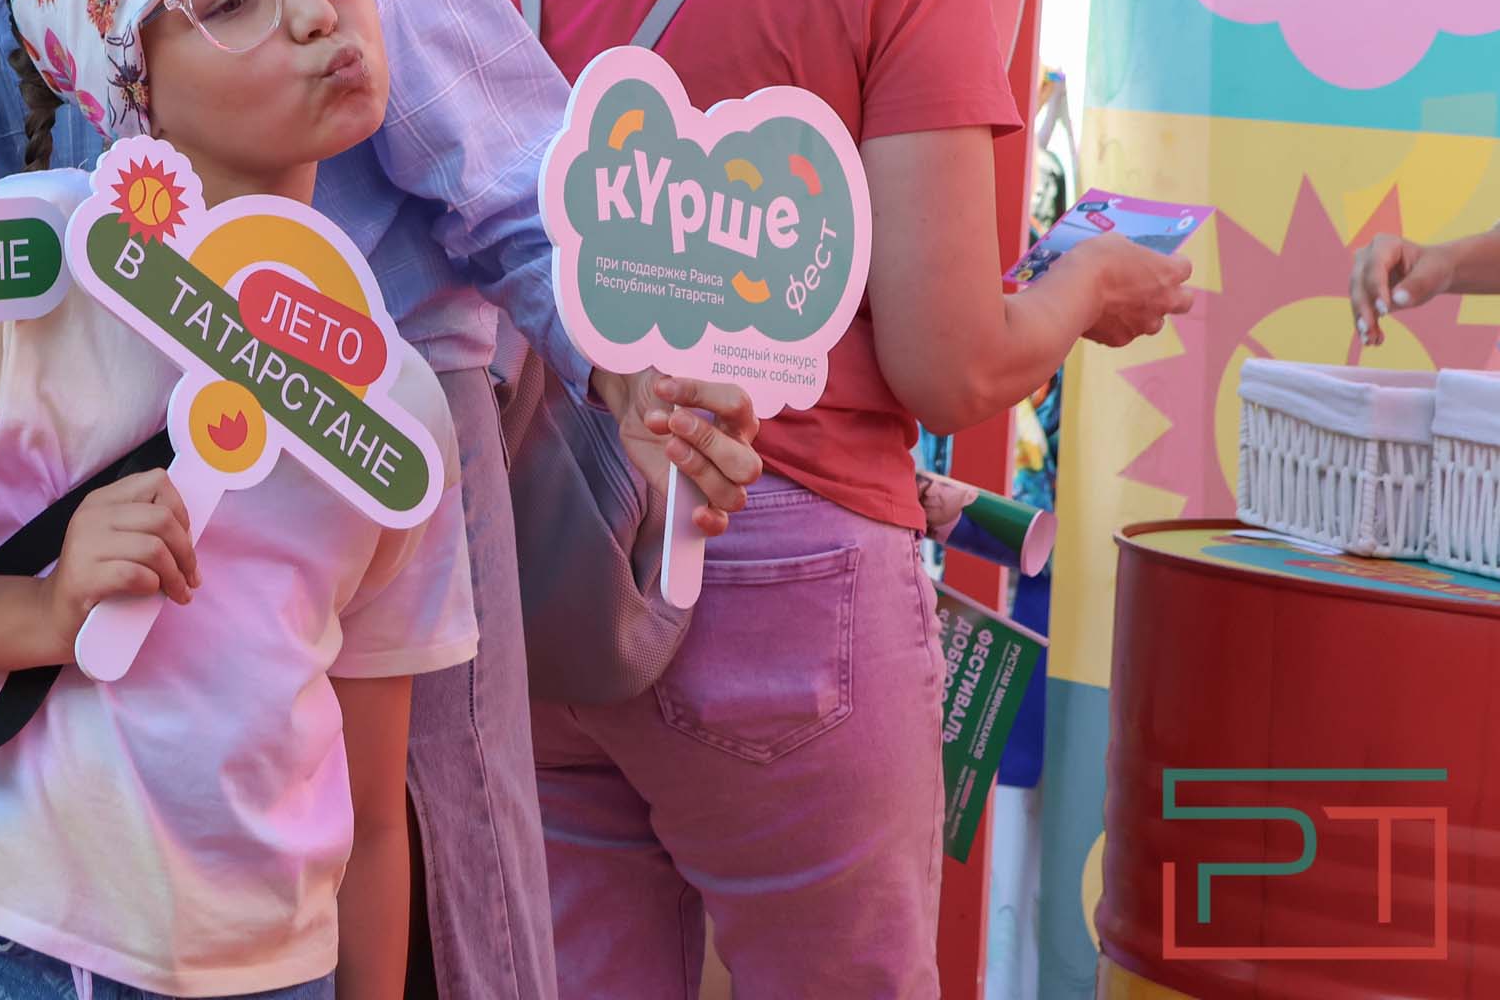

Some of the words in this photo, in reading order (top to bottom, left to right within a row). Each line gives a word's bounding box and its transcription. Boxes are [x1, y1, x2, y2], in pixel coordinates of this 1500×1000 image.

[596, 256, 619, 271] при
[621, 260, 687, 280] поддержке
[690, 268, 723, 287] Раиса
[595, 272, 666, 296] Республики
[668, 283, 725, 305] Татарстан
[260, 289, 364, 367] ЛЕТО
[113, 238, 148, 282] В
[168, 276, 404, 489] ТАТАРСТАНЕ
[713, 343, 770, 361] народный
[773, 353, 818, 369] конкурс
[712, 362, 767, 378] дворовых
[769, 370, 816, 386] событий
[943, 629, 994, 743] ФЕСТИВАЛЬ
